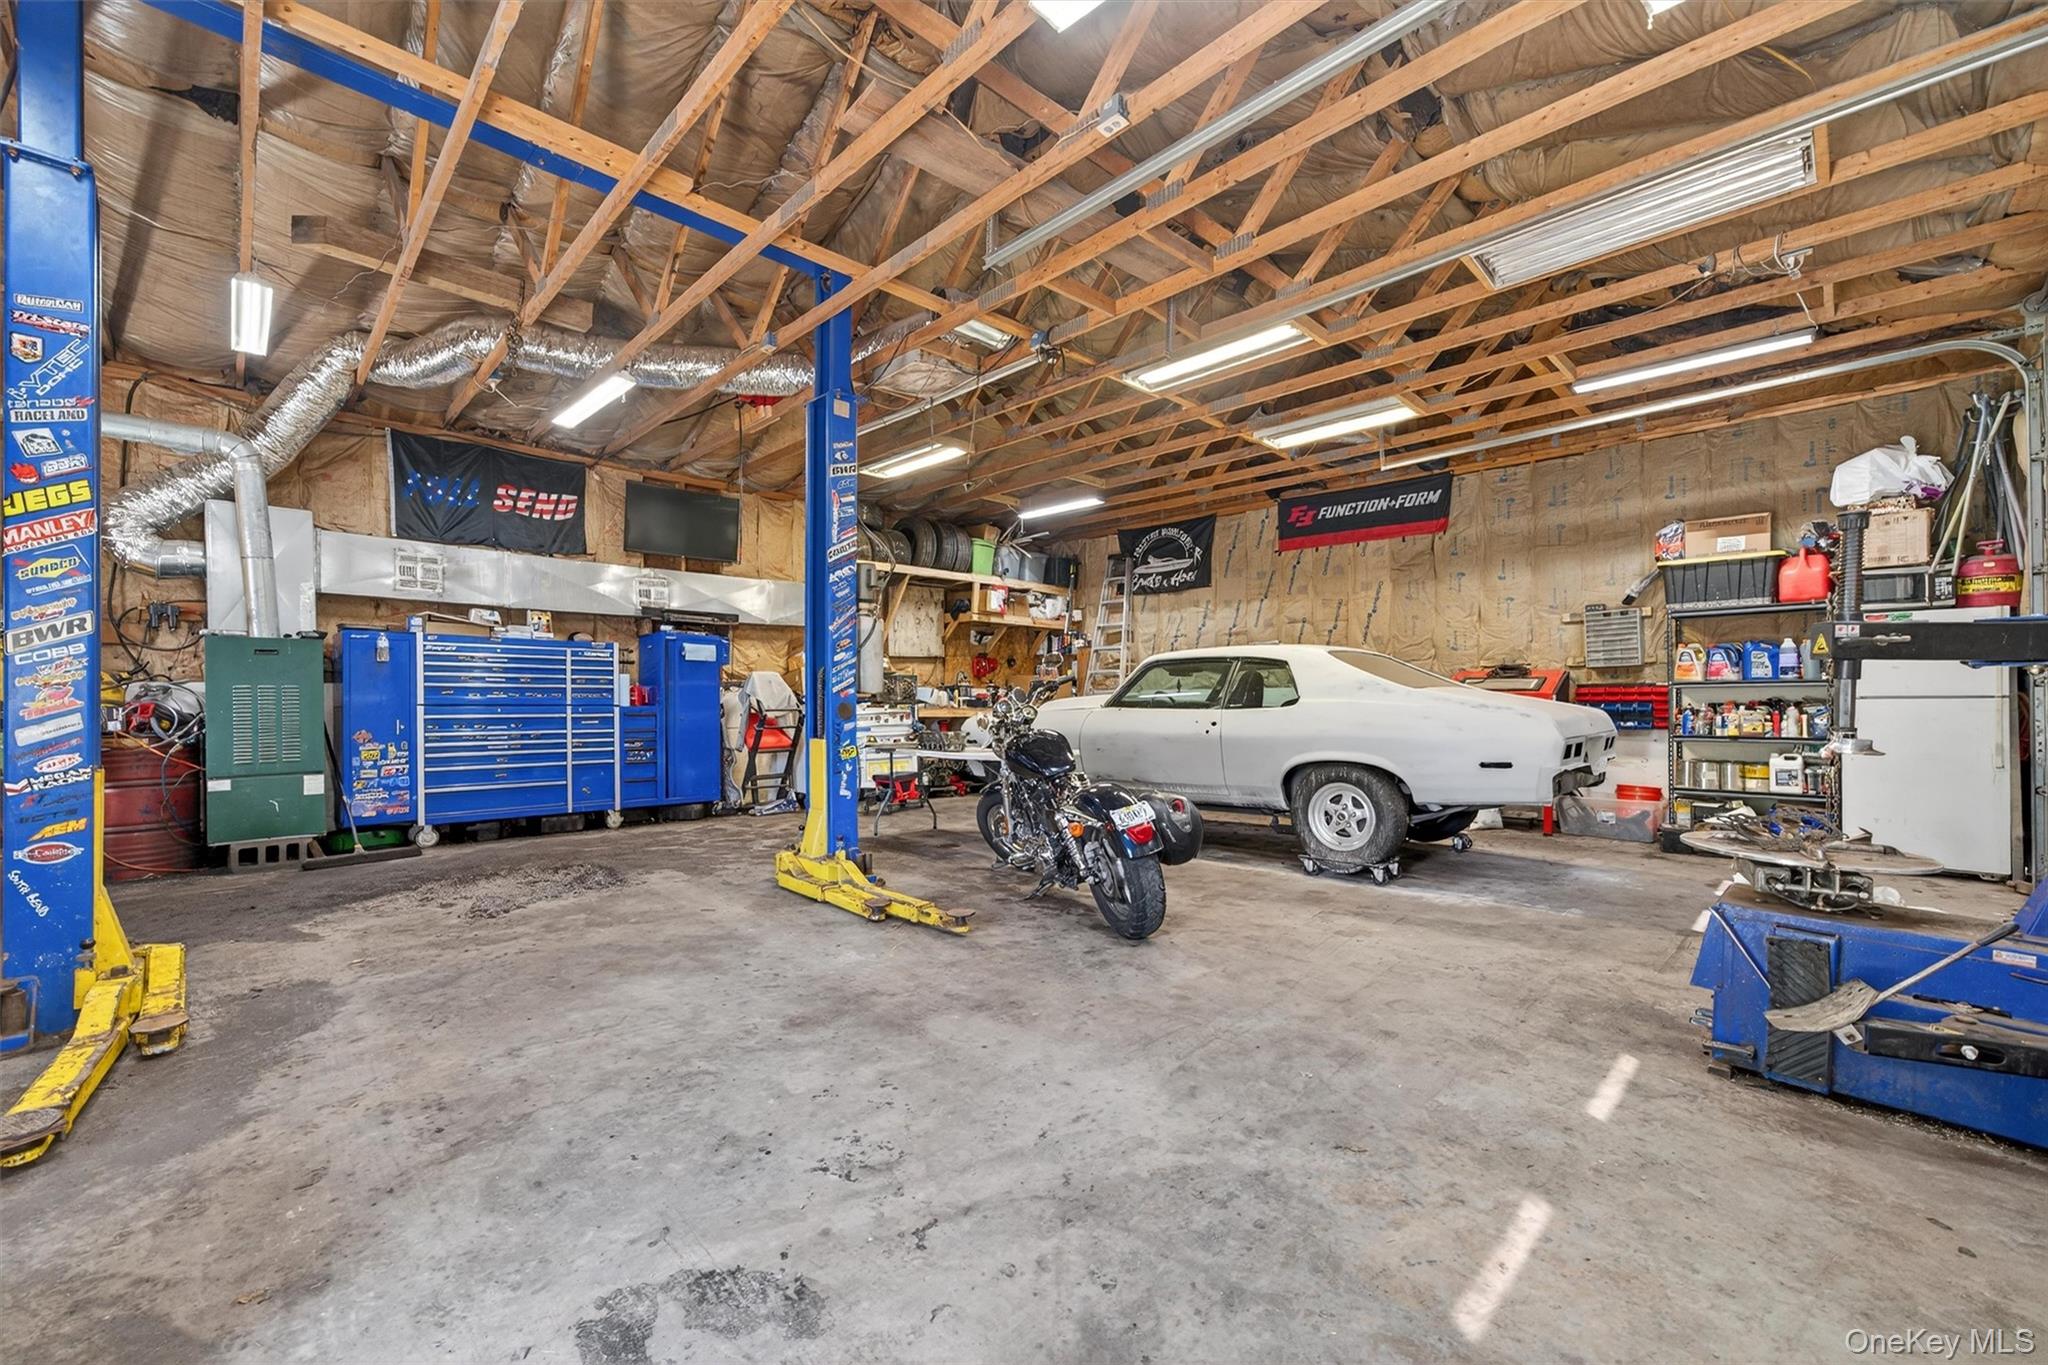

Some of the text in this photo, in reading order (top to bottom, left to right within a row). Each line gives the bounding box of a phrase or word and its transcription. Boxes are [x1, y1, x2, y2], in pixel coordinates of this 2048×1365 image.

[14, 410, 85, 422] RACELAND
[4, 479, 92, 516] JEGS
[493, 484, 578, 521] SEND
[4, 512, 88, 547] MANLEY
[12, 615, 88, 649] BWR
[14, 643, 87, 665] COBB
